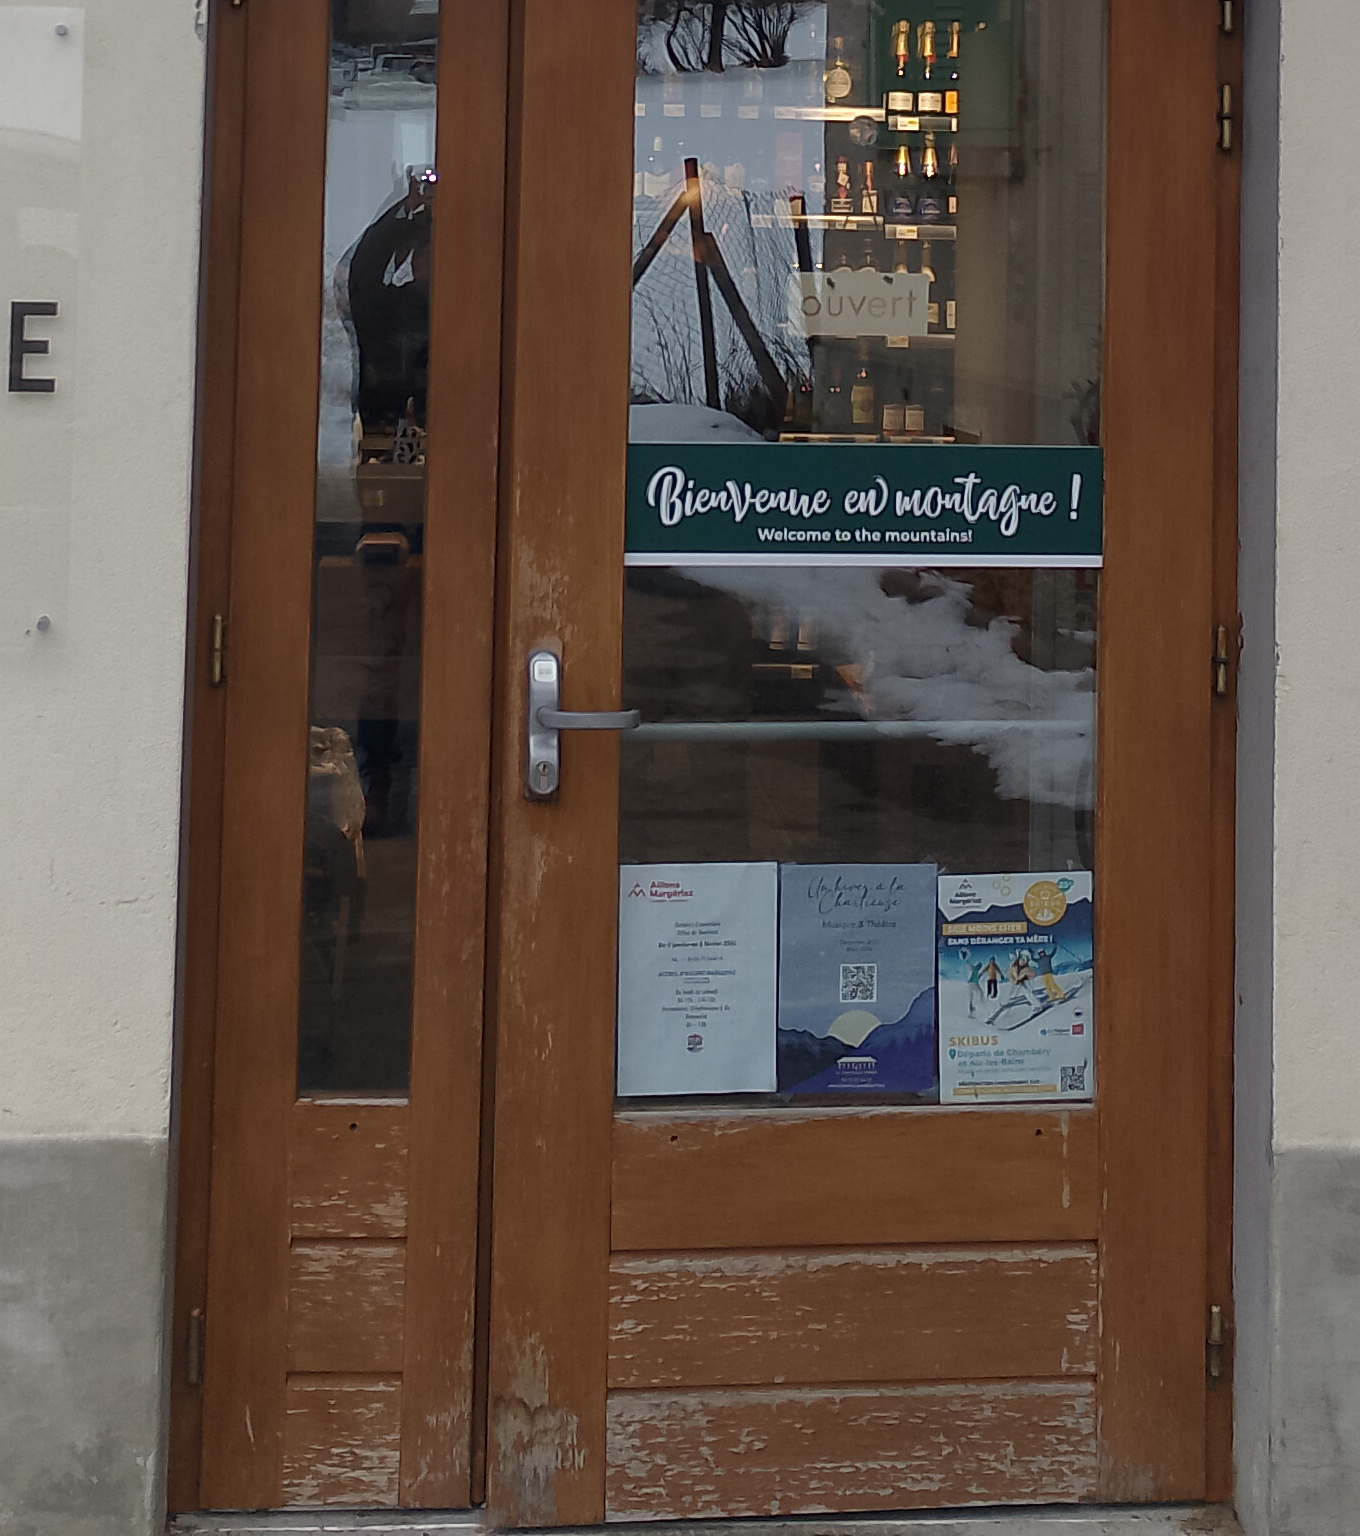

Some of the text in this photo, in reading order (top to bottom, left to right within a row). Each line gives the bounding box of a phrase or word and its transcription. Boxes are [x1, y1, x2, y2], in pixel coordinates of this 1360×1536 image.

[801, 289, 918, 318] ouvert
[646, 466, 1082, 537] Bienvenue en montagne !
[757, 526, 973, 543] Welcome to the mountains!
[948, 1035, 999, 1047] SKIBUS
[993, 1048, 1005, 1057] de
[958, 1059, 967, 1067] et
